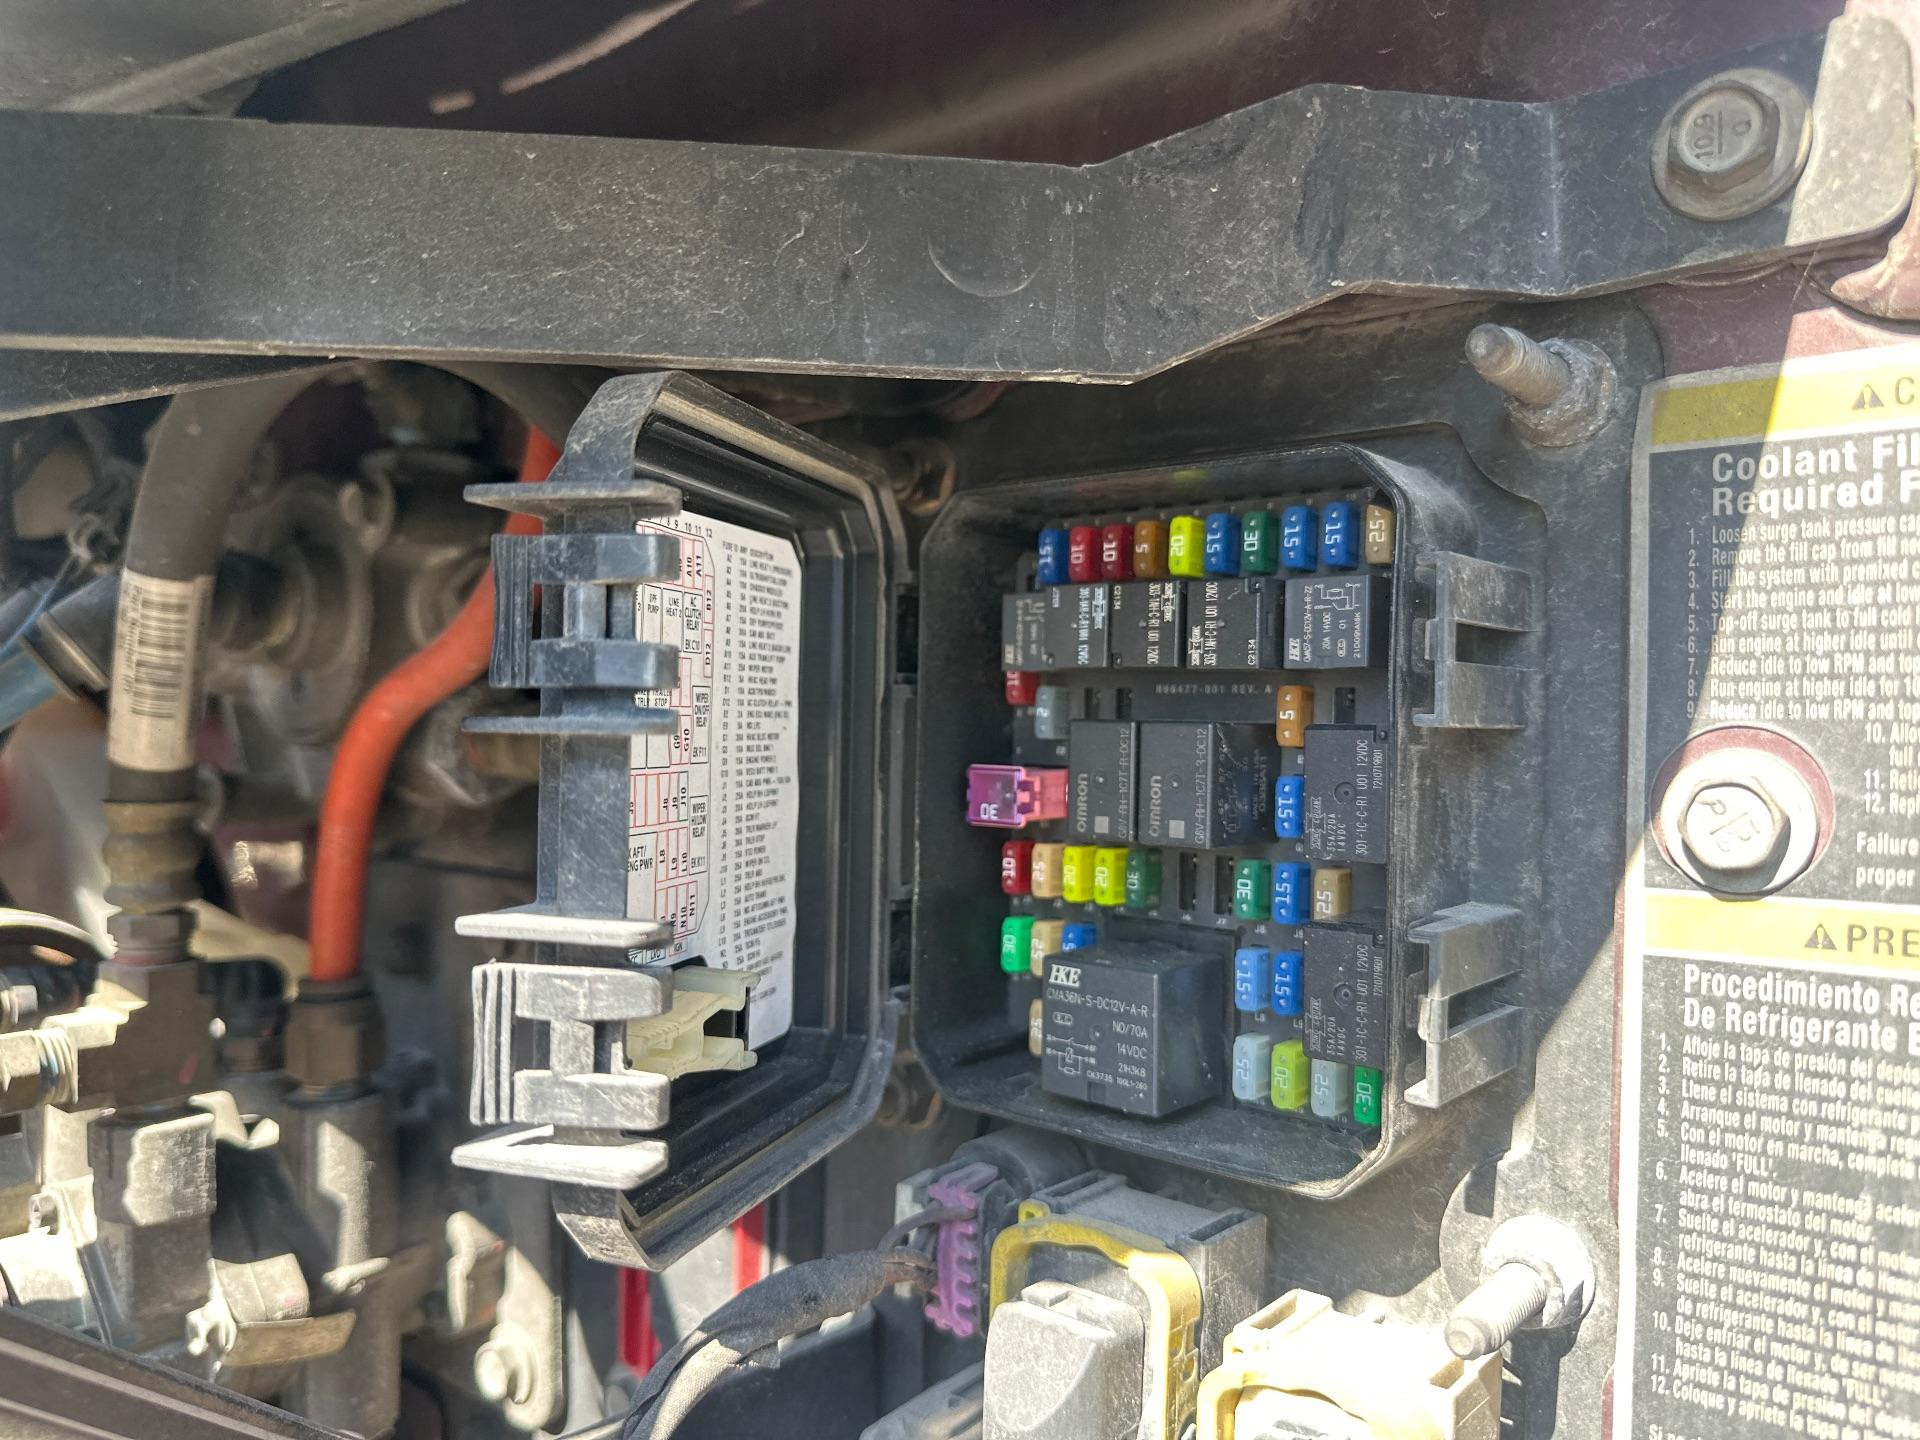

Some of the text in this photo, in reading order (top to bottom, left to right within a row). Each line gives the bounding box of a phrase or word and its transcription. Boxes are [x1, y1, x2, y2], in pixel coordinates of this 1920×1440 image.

[1894, 377, 1915, 405] C
[1712, 440, 1857, 482] Coolant
[1712, 472, 1884, 518] Required
[1244, 531, 1258, 551] 30
[1284, 525, 1299, 547] 15
[1325, 522, 1341, 545] 15
[1369, 520, 1385, 543] 25
[1688, 528, 1700, 545] 1.
[1712, 525, 1756, 544] Loosen
[1760, 522, 1797, 543] surge
[1801, 517, 1830, 538] tank
[1835, 515, 1896, 540] pressure
[1103, 541, 1116, 562] 10
[1136, 544, 1148, 554] 5
[1170, 535, 1184, 557] 20
[1206, 532, 1221, 553] 15
[1688, 550, 1700, 567] 2.
[1712, 547, 1761, 565] Remove
[1765, 543, 1786, 562] the
[1789, 541, 1808, 561] fill
[1811, 543, 1837, 563] cap
[1840, 538, 1874, 558] from
[1876, 535, 1897, 557] fill
[1688, 557, 1908, 588] 3. Fill the system with premixed
[1688, 592, 1700, 610] 4.
[1711, 590, 1742, 609] Start
[1745, 588, 1767, 607] the
[1770, 588, 1815, 611] engine
[1818, 585, 1843, 605] and
[1847, 583, 1873, 604] idle
[1877, 583, 1892, 603] at
[1688, 605, 1911, 634] 5. Top-off surge tank to full cold
[1688, 628, 1913, 656] 6. Run engine at higher idle until
[1036, 707, 1049, 717] 2
[1280, 710, 1296, 721] 5
[1865, 723, 1886, 743] 10.
[1356, 739, 1368, 766] 12VDC
[1889, 745, 1914, 767] full
[1864, 769, 1885, 789] 11.
[980, 803, 998, 820] 30
[1278, 797, 1293, 818] 15
[1864, 793, 1885, 814] 12.
[1856, 832, 1919, 857] Failure
[1095, 867, 1109, 888] 20
[1127, 872, 1140, 888] 30
[1855, 866, 1916, 889] proper
[1237, 879, 1251, 900] 30
[1276, 883, 1291, 905] 15
[1317, 891, 1332, 914] 25
[1846, 923, 1920, 958] PRE
[1356, 944, 1369, 973] 12VDC
[1237, 970, 1251, 992] 15
[1275, 974, 1290, 996] 15
[1683, 963, 1881, 1015] Procedimiento
[1112, 1020, 1149, 1039] NO/70A
[1683, 997, 1716, 1030] De
[1725, 1001, 1898, 1053] Refrigerante
[1117, 1042, 1148, 1060] 14VDC
[1660, 1032, 1873, 1079] 1. Afloje la tapa de presión del
[1236, 1058, 1249, 1080] 25
[1274, 1067, 1289, 1089] 20
[1658, 1053, 1873, 1102] 2. Retire la tapa de llenado del
[1315, 1073, 1329, 1096] 25
[1356, 1082, 1372, 1106] 30
[1681, 1143, 1728, 1170] llenado
[1656, 1161, 1787, 1202] 6. Acelere el motor
[1651, 1374, 1736, 1416] 12. Coloque y
